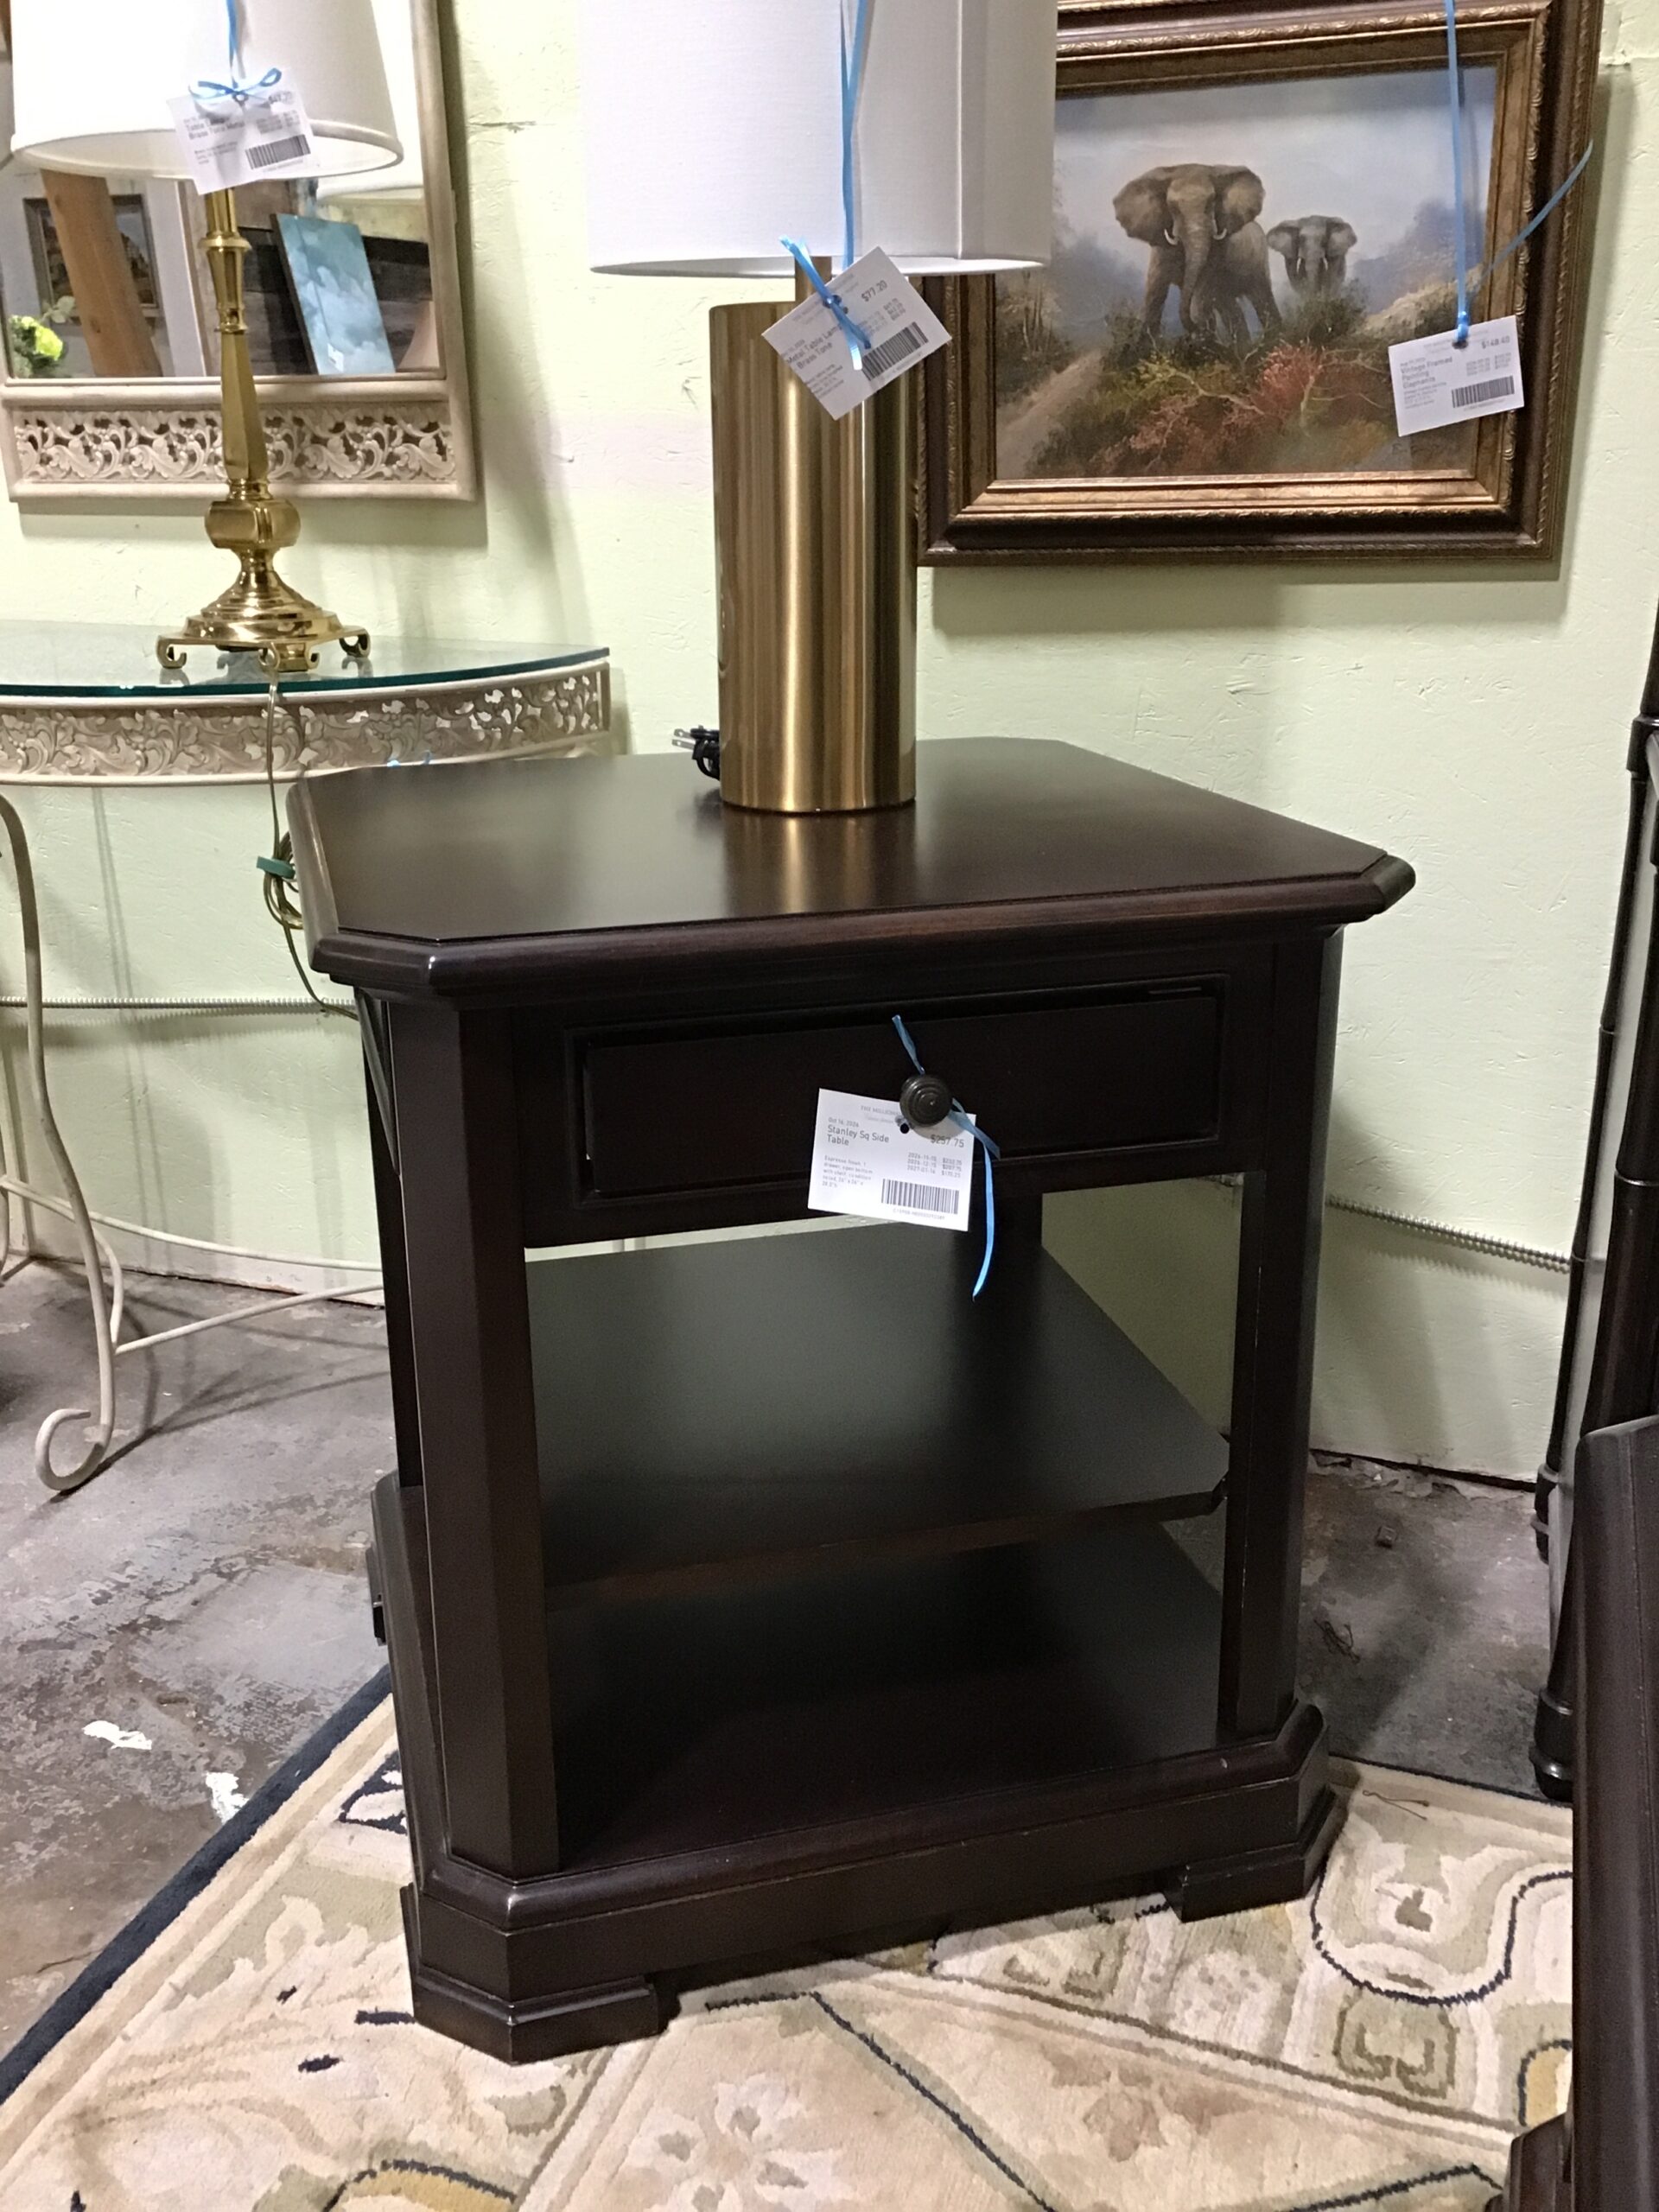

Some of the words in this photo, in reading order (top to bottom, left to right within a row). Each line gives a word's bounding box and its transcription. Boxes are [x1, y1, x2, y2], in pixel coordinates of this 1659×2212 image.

[861, 279, 887, 302] $77.20
[804, 337, 823, 352] Table
[797, 354, 817, 370] Brass
[815, 342, 832, 355] Tone
[1401, 364, 1426, 374] Vintage
[1427, 356, 1452, 367] Framed
[827, 1123, 858, 1139] Stanley
[859, 1130, 870, 1141] Sq
[872, 1132, 889, 1142] Side
[827, 1134, 849, 1146] Table
[930, 1134, 964, 1148] $257.75
